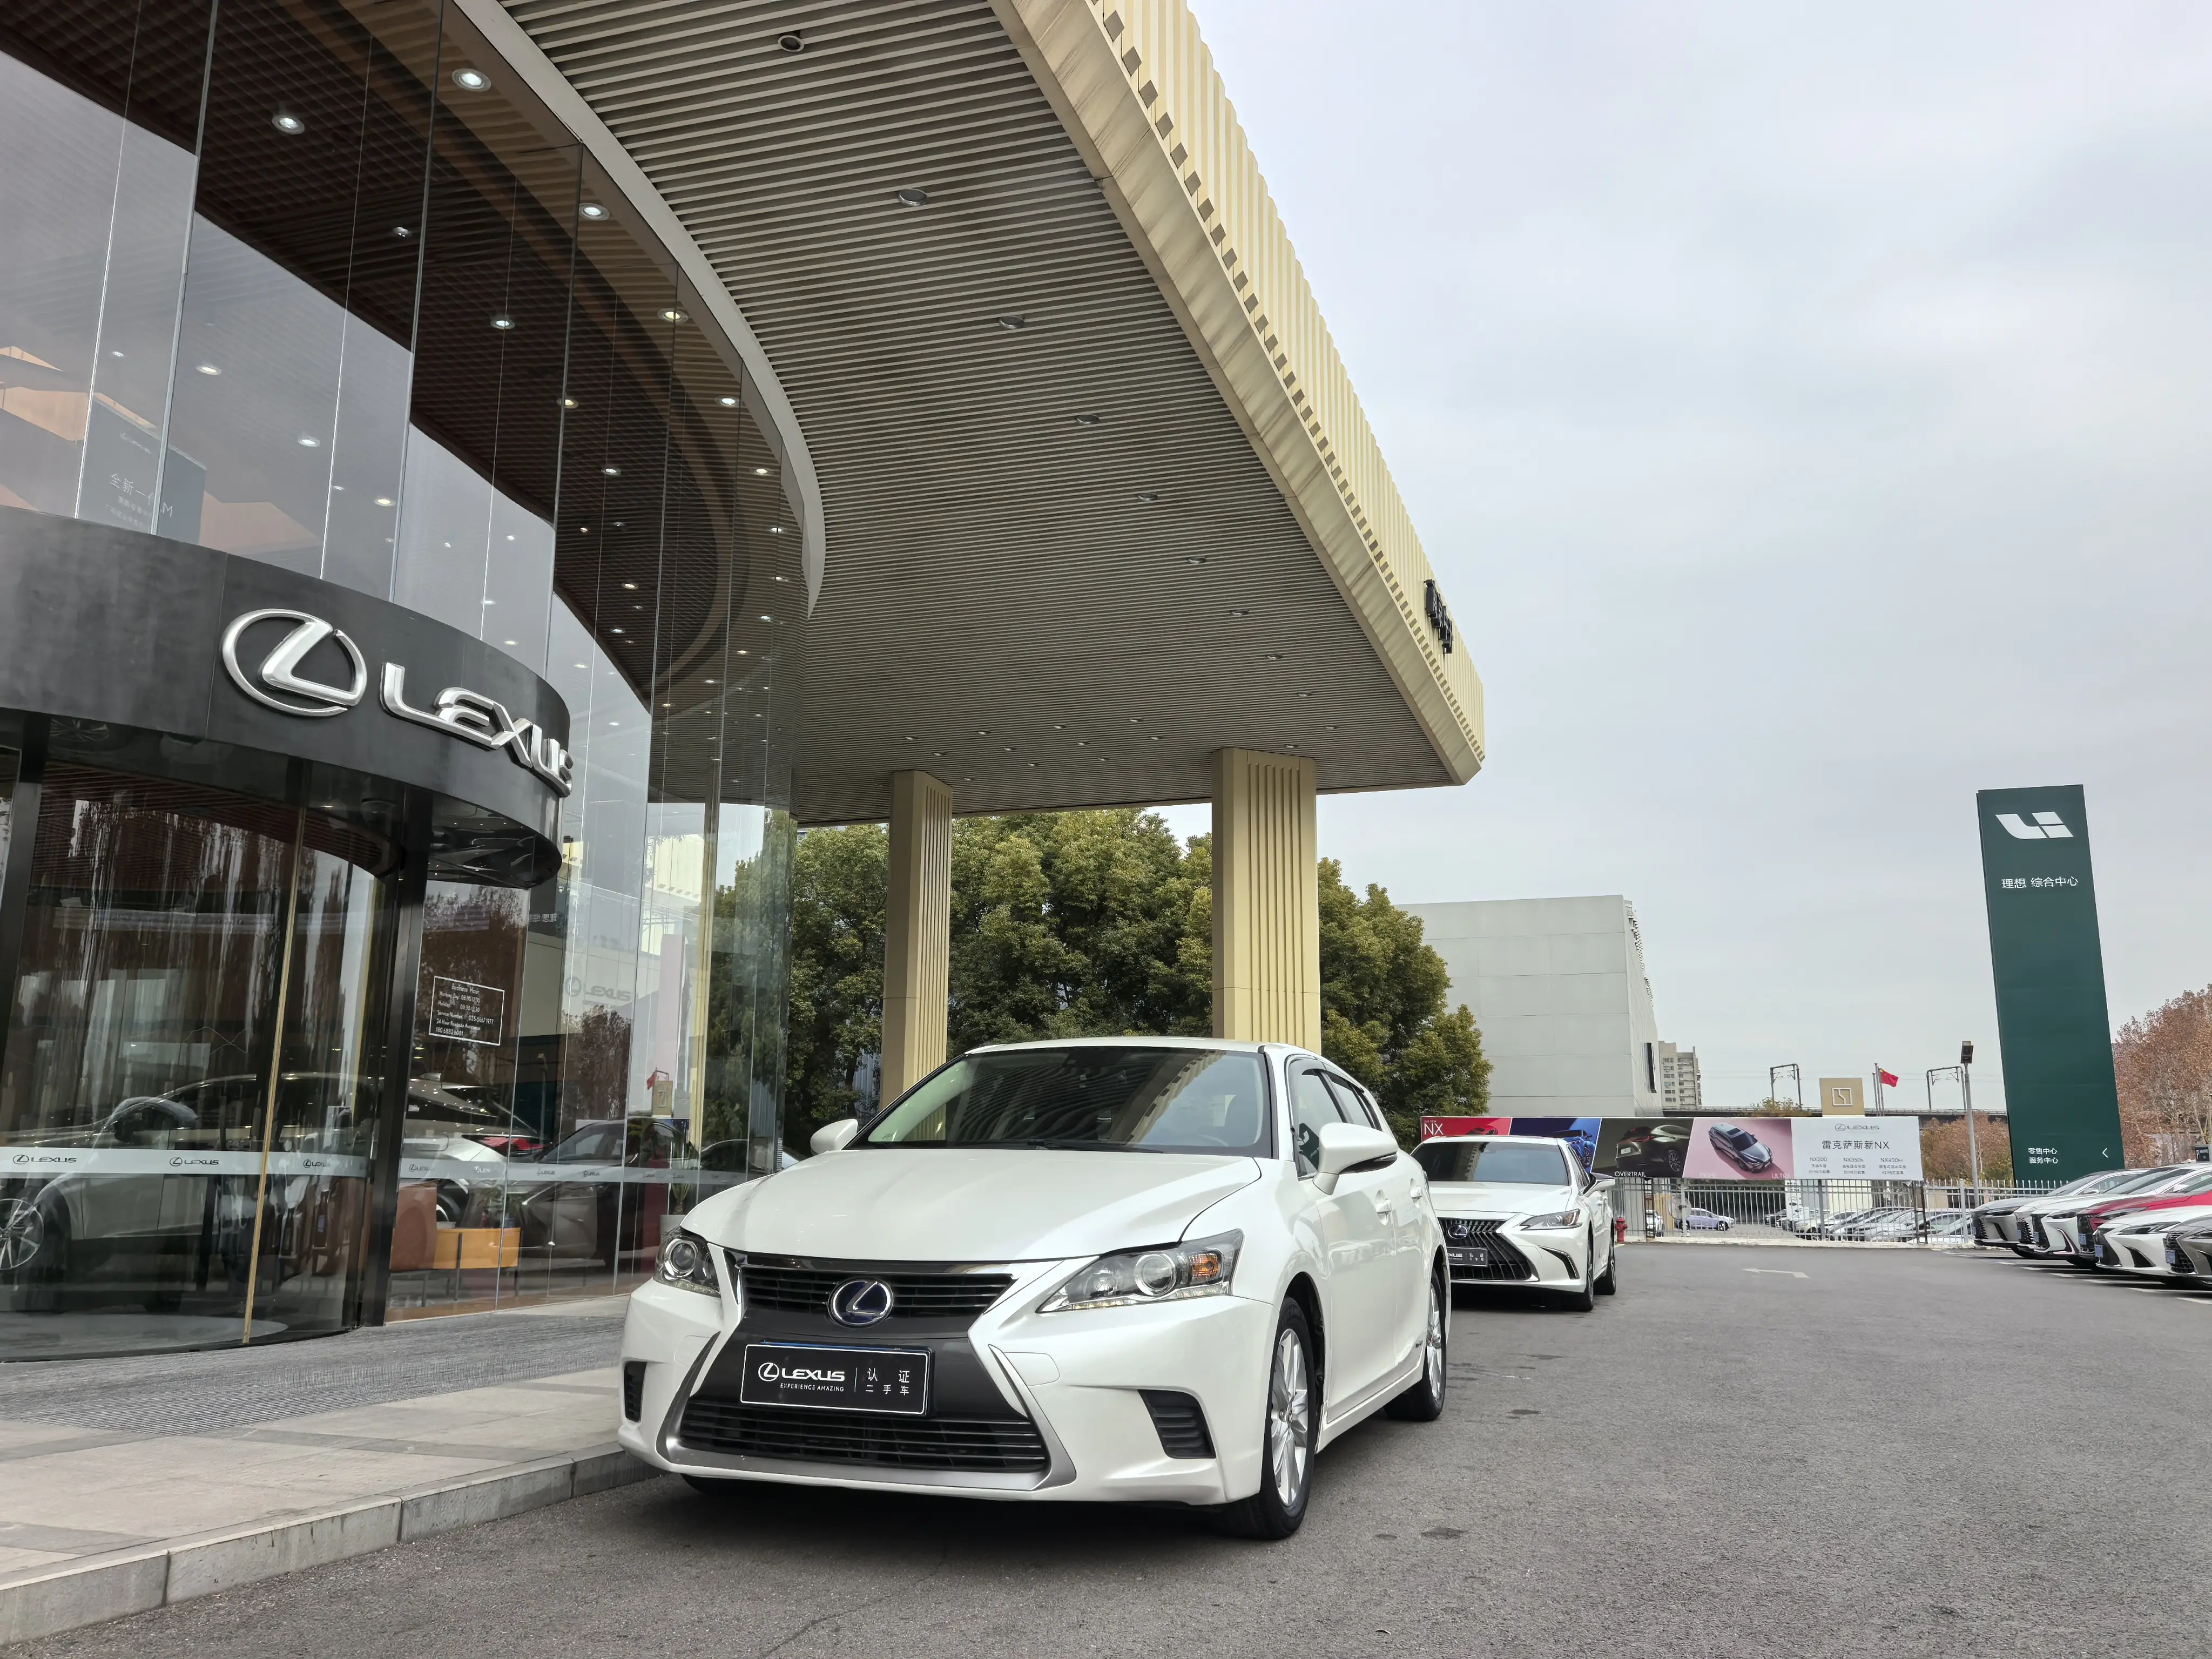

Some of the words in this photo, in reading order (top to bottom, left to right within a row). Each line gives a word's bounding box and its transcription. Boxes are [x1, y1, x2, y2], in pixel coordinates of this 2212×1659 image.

[380, 662, 574, 798] LEXUS
[2001, 878, 2027, 889] 理想
[2031, 876, 2079, 888] 综合中心
[451, 983, 468, 993] Business
[1424, 1123, 1444, 1135] NX
[1822, 1140, 1890, 1150] 雷克萨斯新NX
[781, 1367, 845, 1382] LEXUS
[780, 1382, 815, 1391] EXPERIENCE
[817, 1384, 845, 1392] AMAZING
